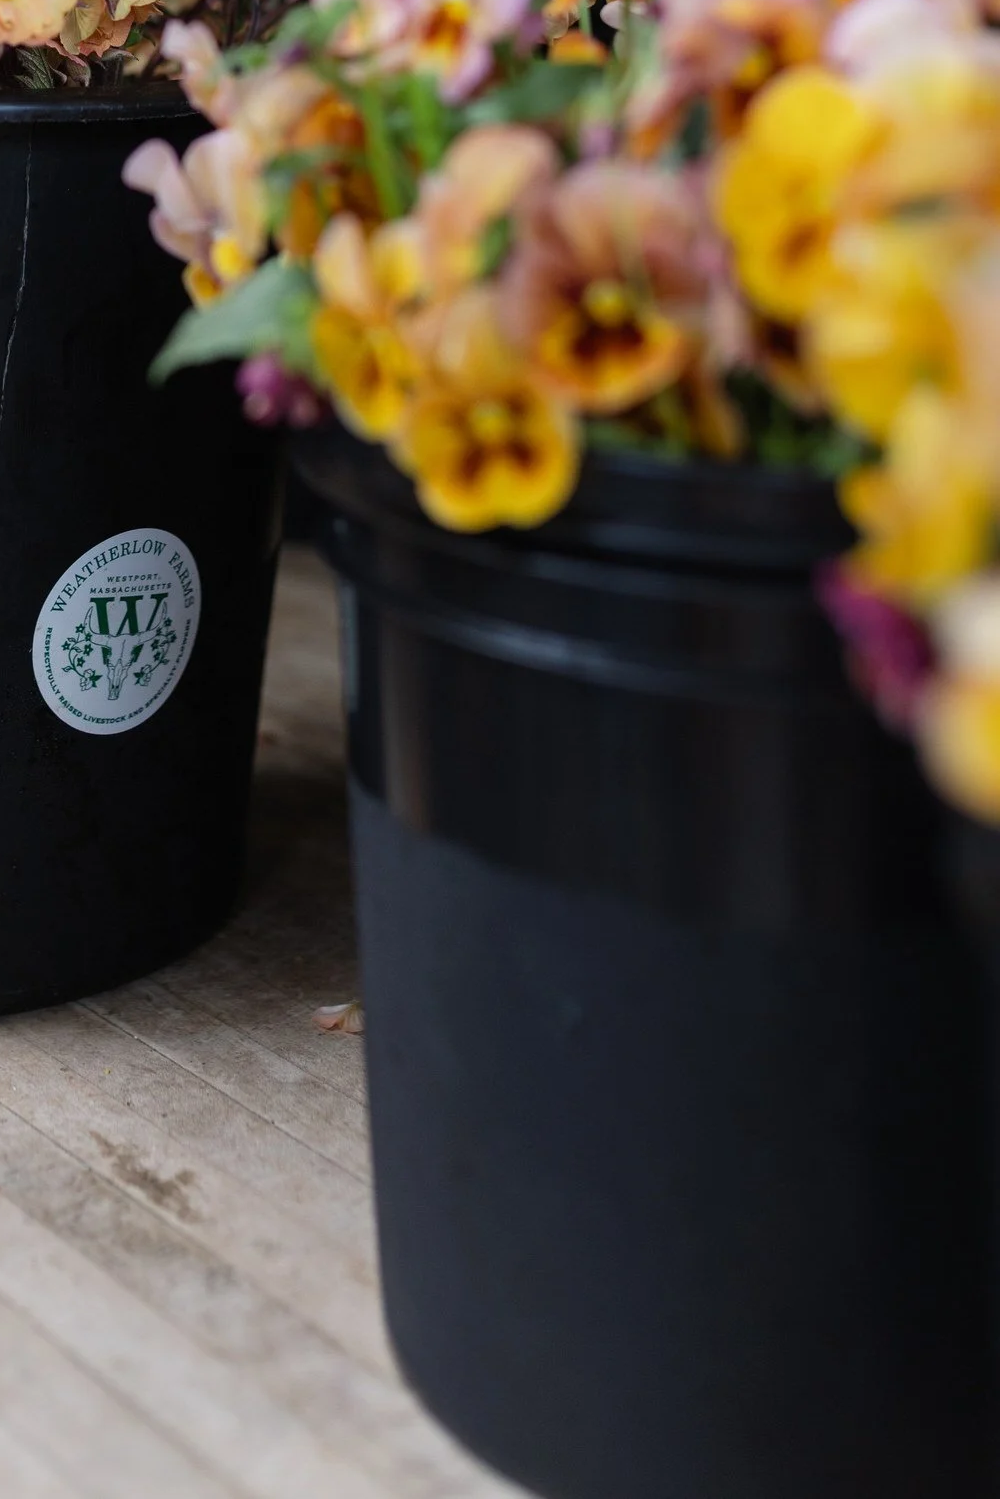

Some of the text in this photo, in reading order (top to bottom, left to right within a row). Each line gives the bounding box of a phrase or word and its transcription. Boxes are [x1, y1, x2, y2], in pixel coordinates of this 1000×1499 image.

[51, 539, 195, 614] WEATHERLOW FARMS
[90, 582, 172, 594] MASSACHUSETTS
[90, 592, 169, 665] W
[44, 627, 61, 695] RESPECTFULLY
[58, 695, 83, 718] RAISED
[83, 713, 127, 724] LIVESTOCK
[127, 707, 144, 720] AND
